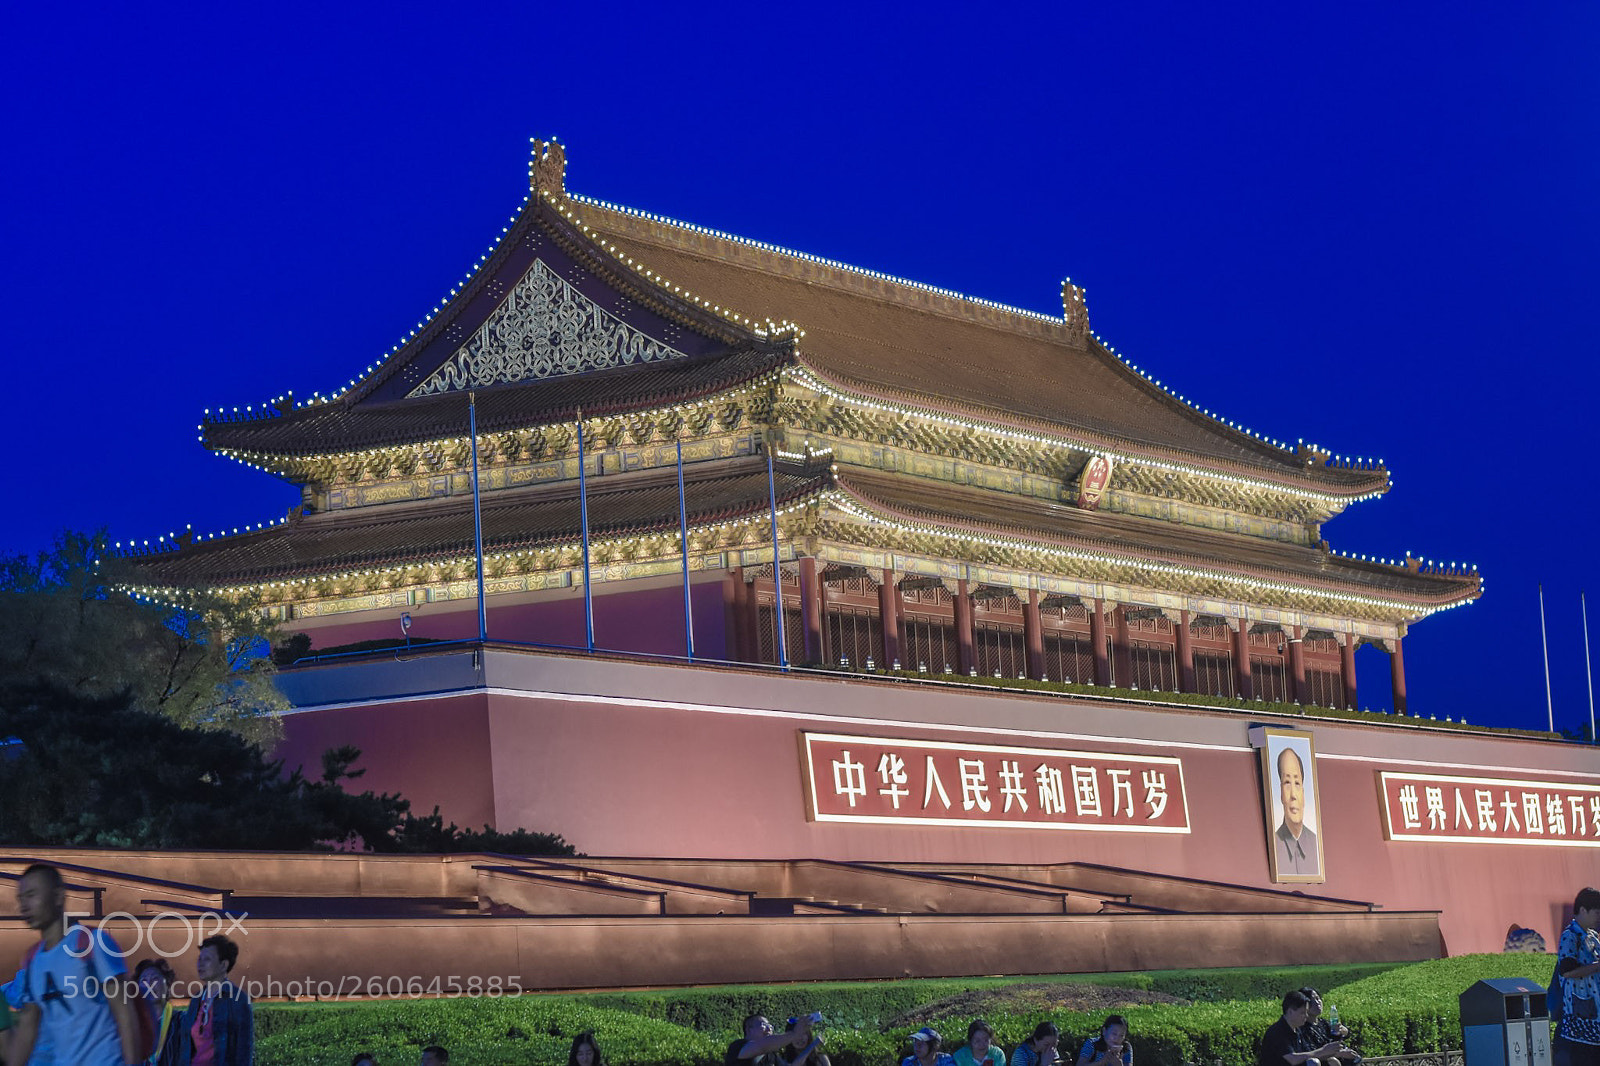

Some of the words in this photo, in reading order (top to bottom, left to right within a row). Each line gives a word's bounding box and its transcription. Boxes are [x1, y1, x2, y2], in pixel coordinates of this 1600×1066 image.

[832, 750, 1168, 820] 中华人民共和国万岁
